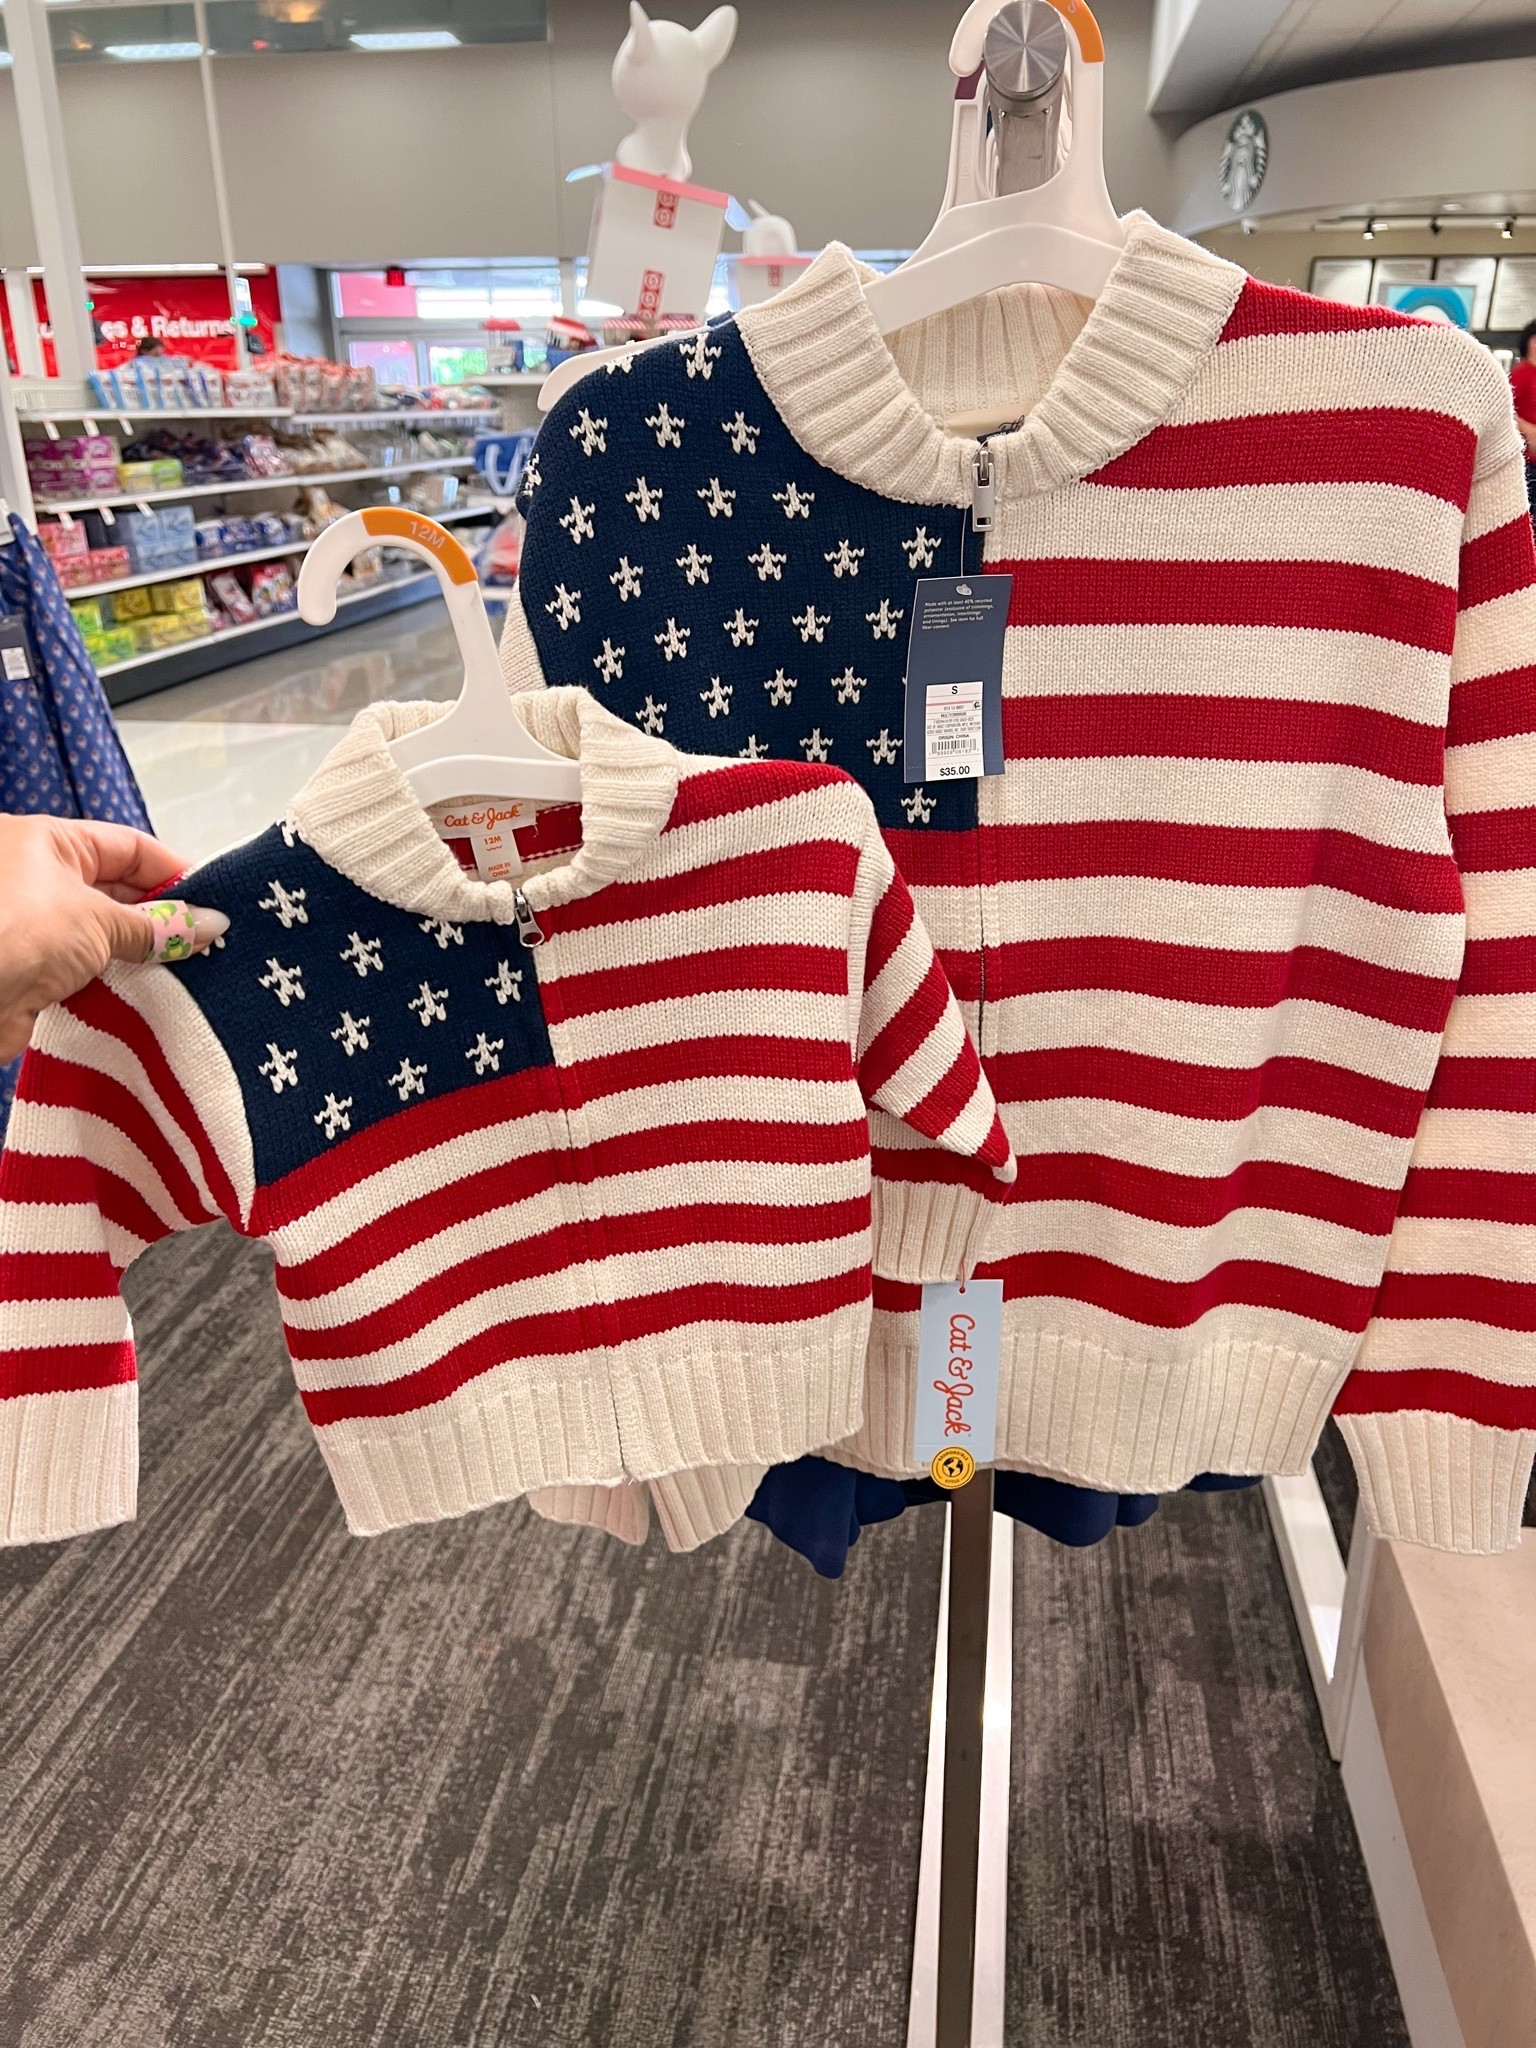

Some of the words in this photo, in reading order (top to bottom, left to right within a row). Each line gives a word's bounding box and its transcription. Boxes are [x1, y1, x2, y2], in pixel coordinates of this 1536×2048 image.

[131, 315, 148, 338] &
[410, 520, 446, 549] 12M
[951, 685, 958, 695] S
[939, 765, 970, 777] $35.00
[444, 815, 470, 827] Cat
[471, 811, 486, 825] &
[486, 804, 521, 830] Jack
[483, 835, 502, 846] 12M
[488, 863, 504, 872] MADE
[492, 869, 511, 878] CHINA
[949, 1313, 976, 1354] Cat
[948, 1356, 973, 1380] &
[933, 1379, 974, 1438] Jack
